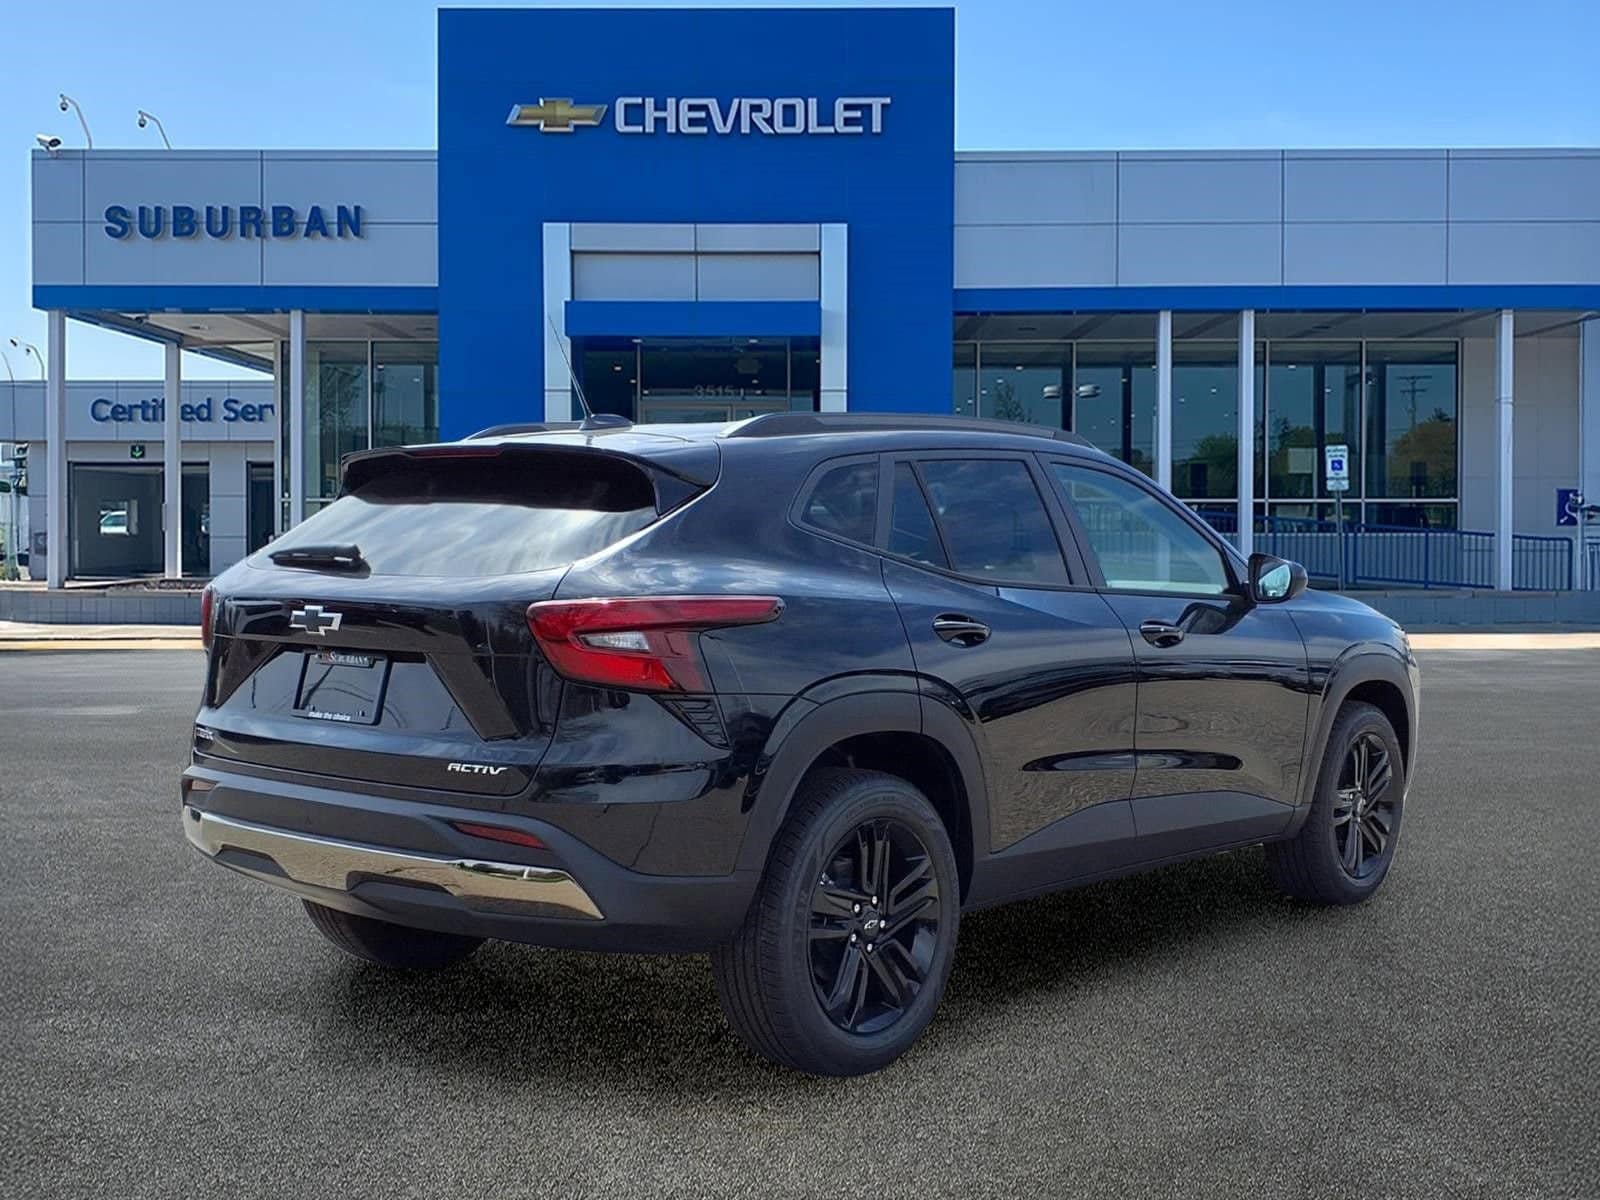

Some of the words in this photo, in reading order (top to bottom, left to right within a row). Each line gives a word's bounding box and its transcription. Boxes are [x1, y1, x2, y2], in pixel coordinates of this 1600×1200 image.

[614, 97, 891, 134] CHEVROLET
[105, 205, 363, 239] SUBURBAN
[91, 397, 212, 423] Certifed
[447, 762, 509, 775] ACTIV
